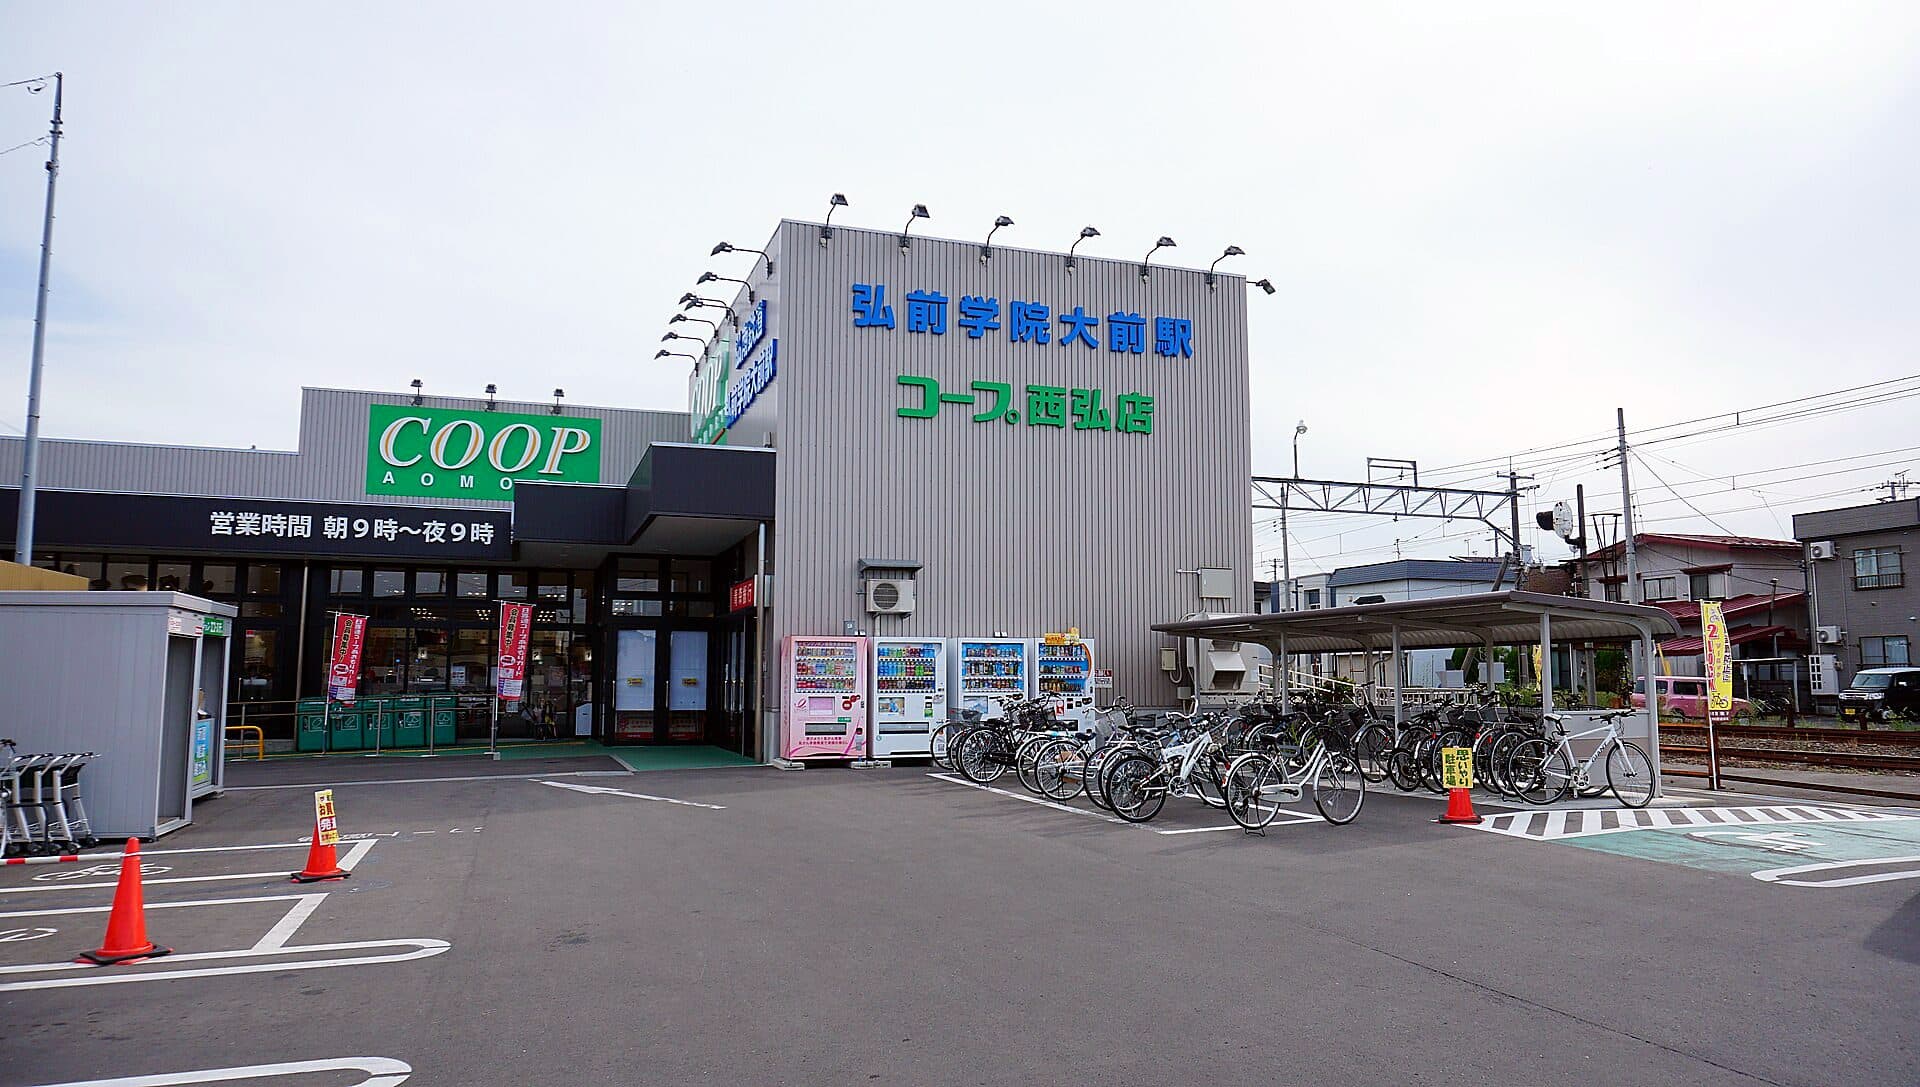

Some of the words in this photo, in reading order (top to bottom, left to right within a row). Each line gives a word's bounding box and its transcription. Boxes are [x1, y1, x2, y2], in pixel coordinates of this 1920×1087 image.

[852, 283, 1193, 358] 弘前学院大前駅
[379, 416, 592, 475] COOP
[382, 471, 513, 490] AOMO
[209, 511, 313, 538] 営業時間
[1445, 754, 1456, 785] 駐車場
[1456, 750, 1469, 786] 思いやり
